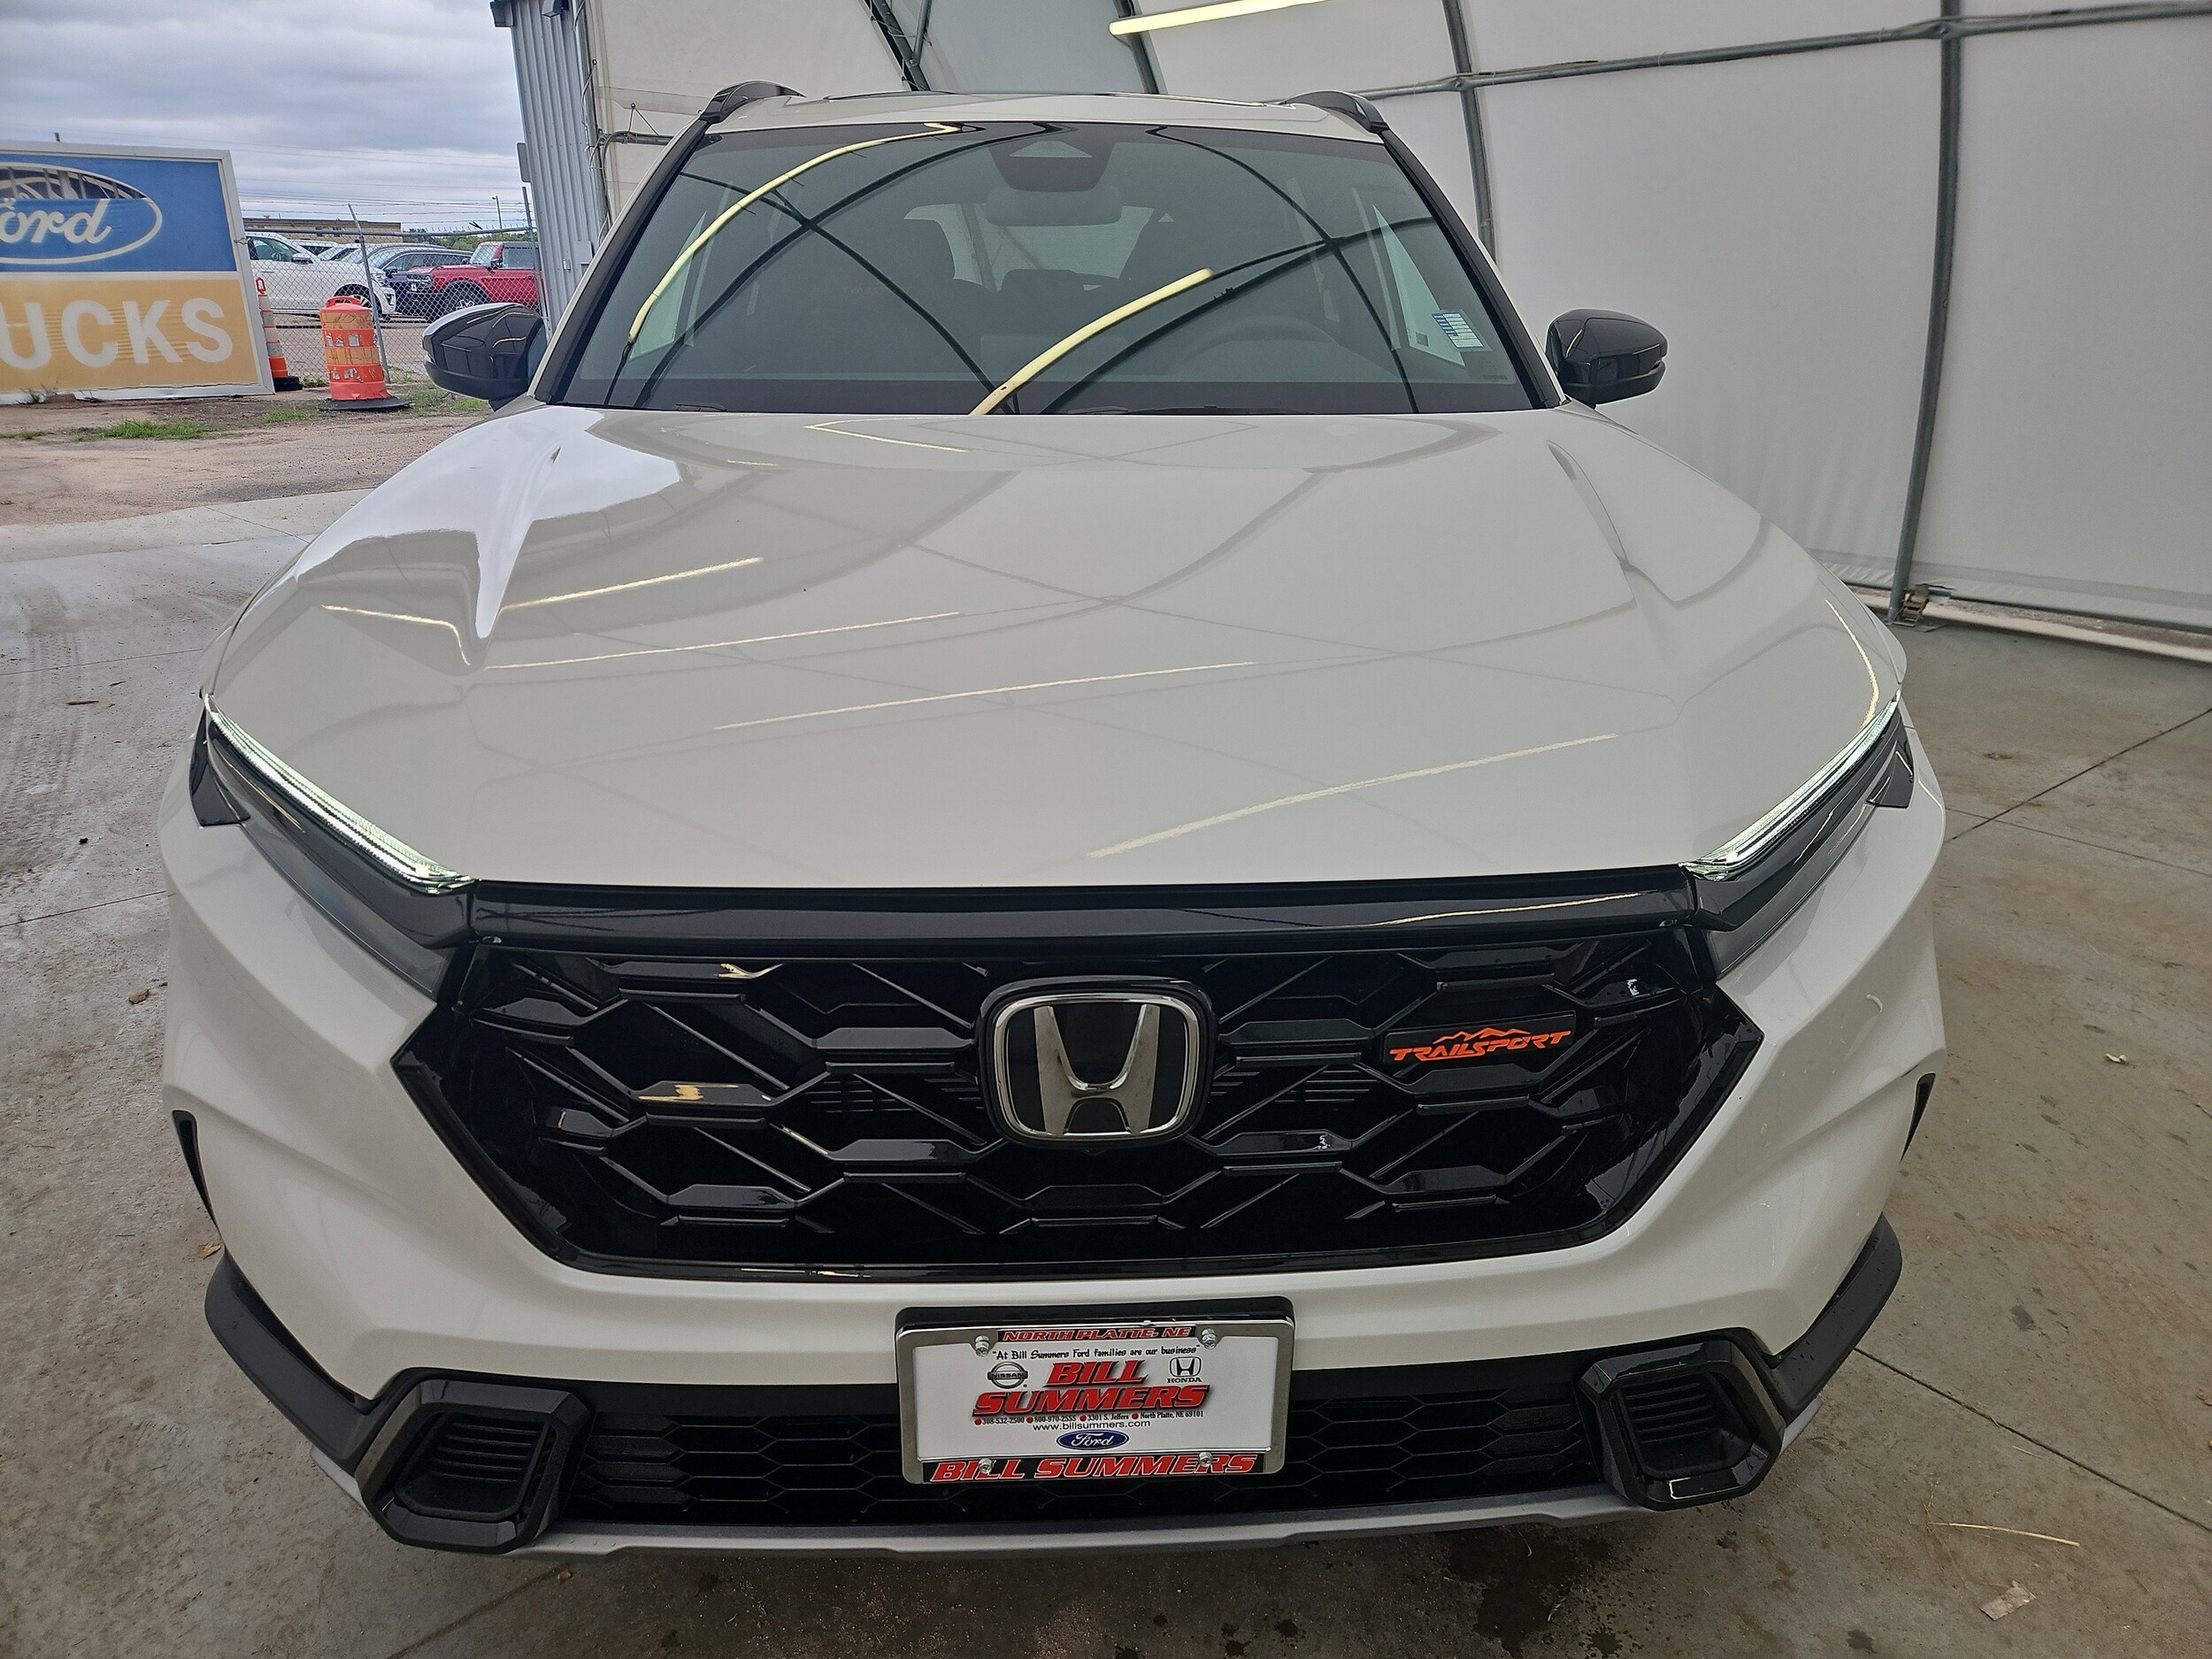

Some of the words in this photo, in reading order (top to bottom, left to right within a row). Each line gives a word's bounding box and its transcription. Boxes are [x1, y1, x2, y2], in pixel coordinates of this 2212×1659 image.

[0, 197, 112, 243] ord
[1389, 1030, 1571, 1062] TRAILSPORT
[1002, 1330, 1074, 1341] NORTH
[1161, 1327, 1192, 1338] NE
[1011, 1350, 1027, 1360] Bill
[1030, 1349, 1070, 1359] Summers
[1072, 1348, 1090, 1358] Ford
[1094, 1348, 1126, 1357] families
[1043, 1360, 1148, 1387] BILL
[972, 1384, 1210, 1417] SUMMERS
[982, 1416, 1025, 1425] 308-532-2500
[1033, 1420, 1151, 1431] www.billsummers.com
[1071, 1432, 1114, 1448] Ford
[1033, 1454, 1257, 1478] SUMMERS
